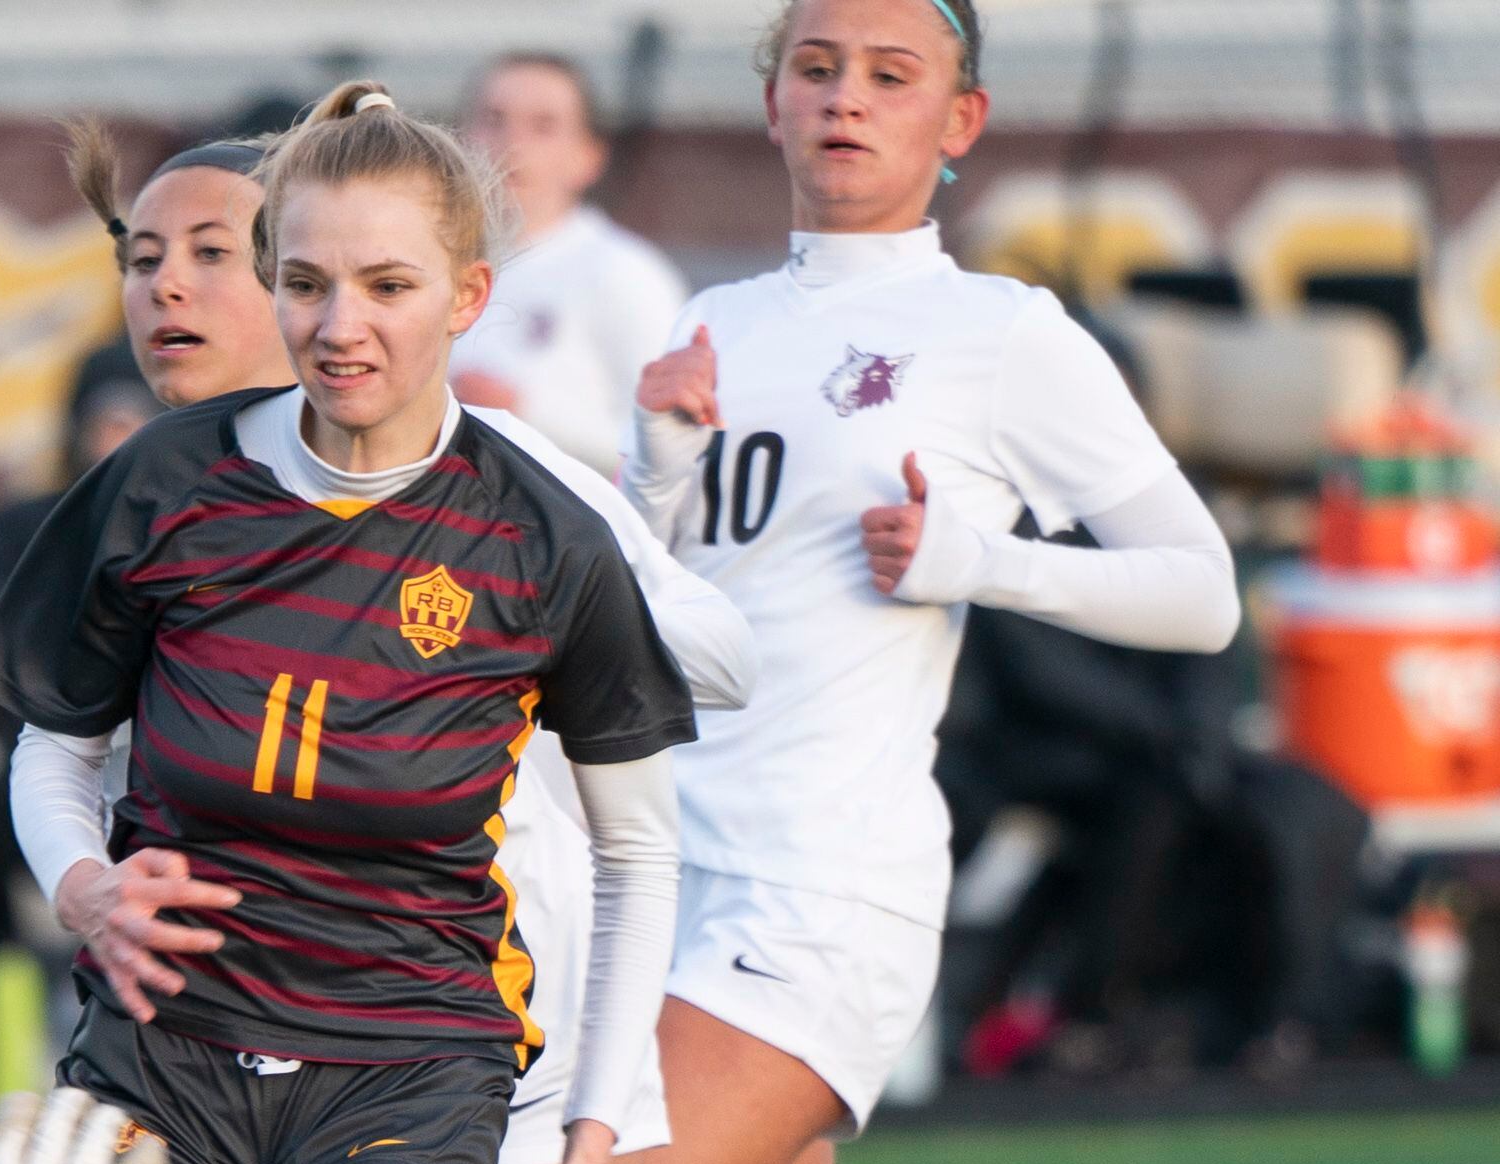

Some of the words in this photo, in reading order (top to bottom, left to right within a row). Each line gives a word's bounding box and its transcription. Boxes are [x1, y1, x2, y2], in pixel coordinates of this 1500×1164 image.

[697, 431, 785, 546] 10
[417, 592, 454, 613] RB
[252, 673, 329, 801] 11
